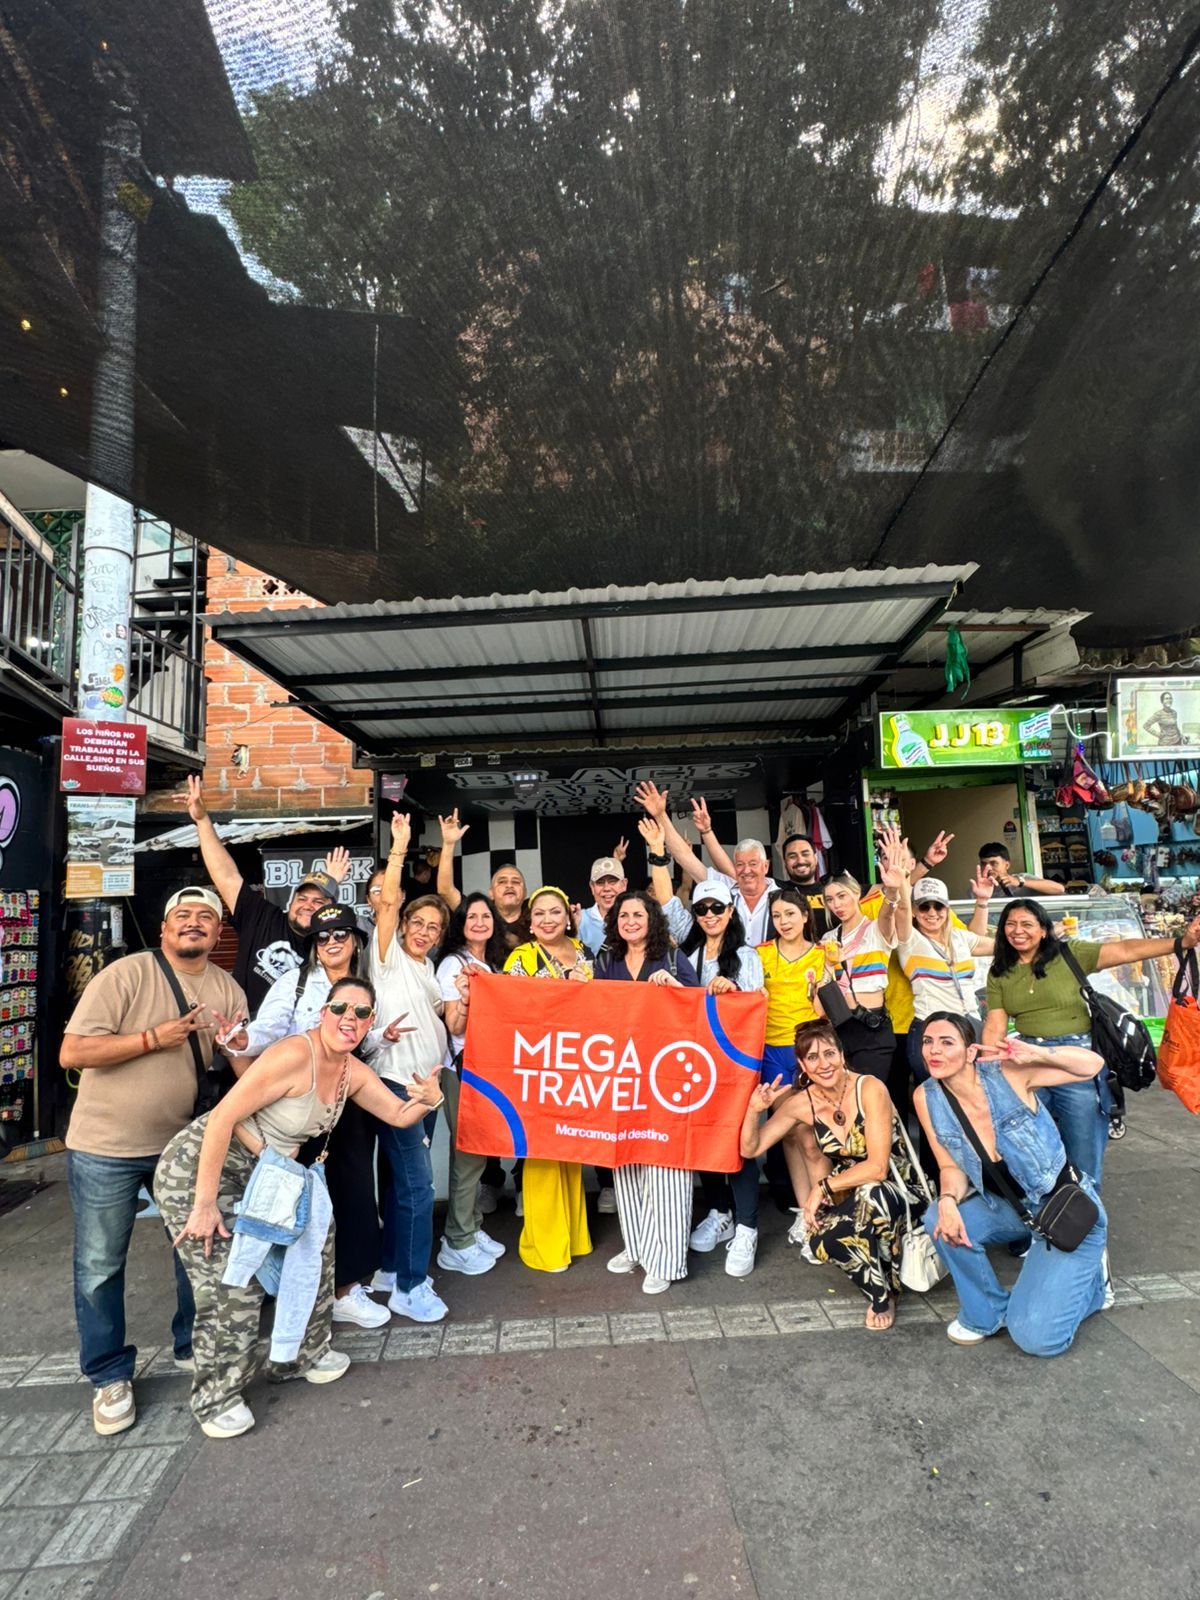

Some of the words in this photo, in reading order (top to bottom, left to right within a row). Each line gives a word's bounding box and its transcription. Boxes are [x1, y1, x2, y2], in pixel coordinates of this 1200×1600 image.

[76, 727, 93, 736] LOS
[95, 728, 121, 738] NIÑOS
[123, 731, 136, 739] NO
[84, 737, 128, 747] DEBERÍAN
[70, 745, 114, 755] TRABAJAR
[115, 757, 127, 765] EN
[128, 758, 145, 766] SUS
[513, 1029, 642, 1074] MEGA
[513, 1068, 648, 1111] TRAVEL
[555, 1123, 617, 1142] Marcamos
[618, 1129, 627, 1141] el
[627, 1128, 670, 1142] destino
